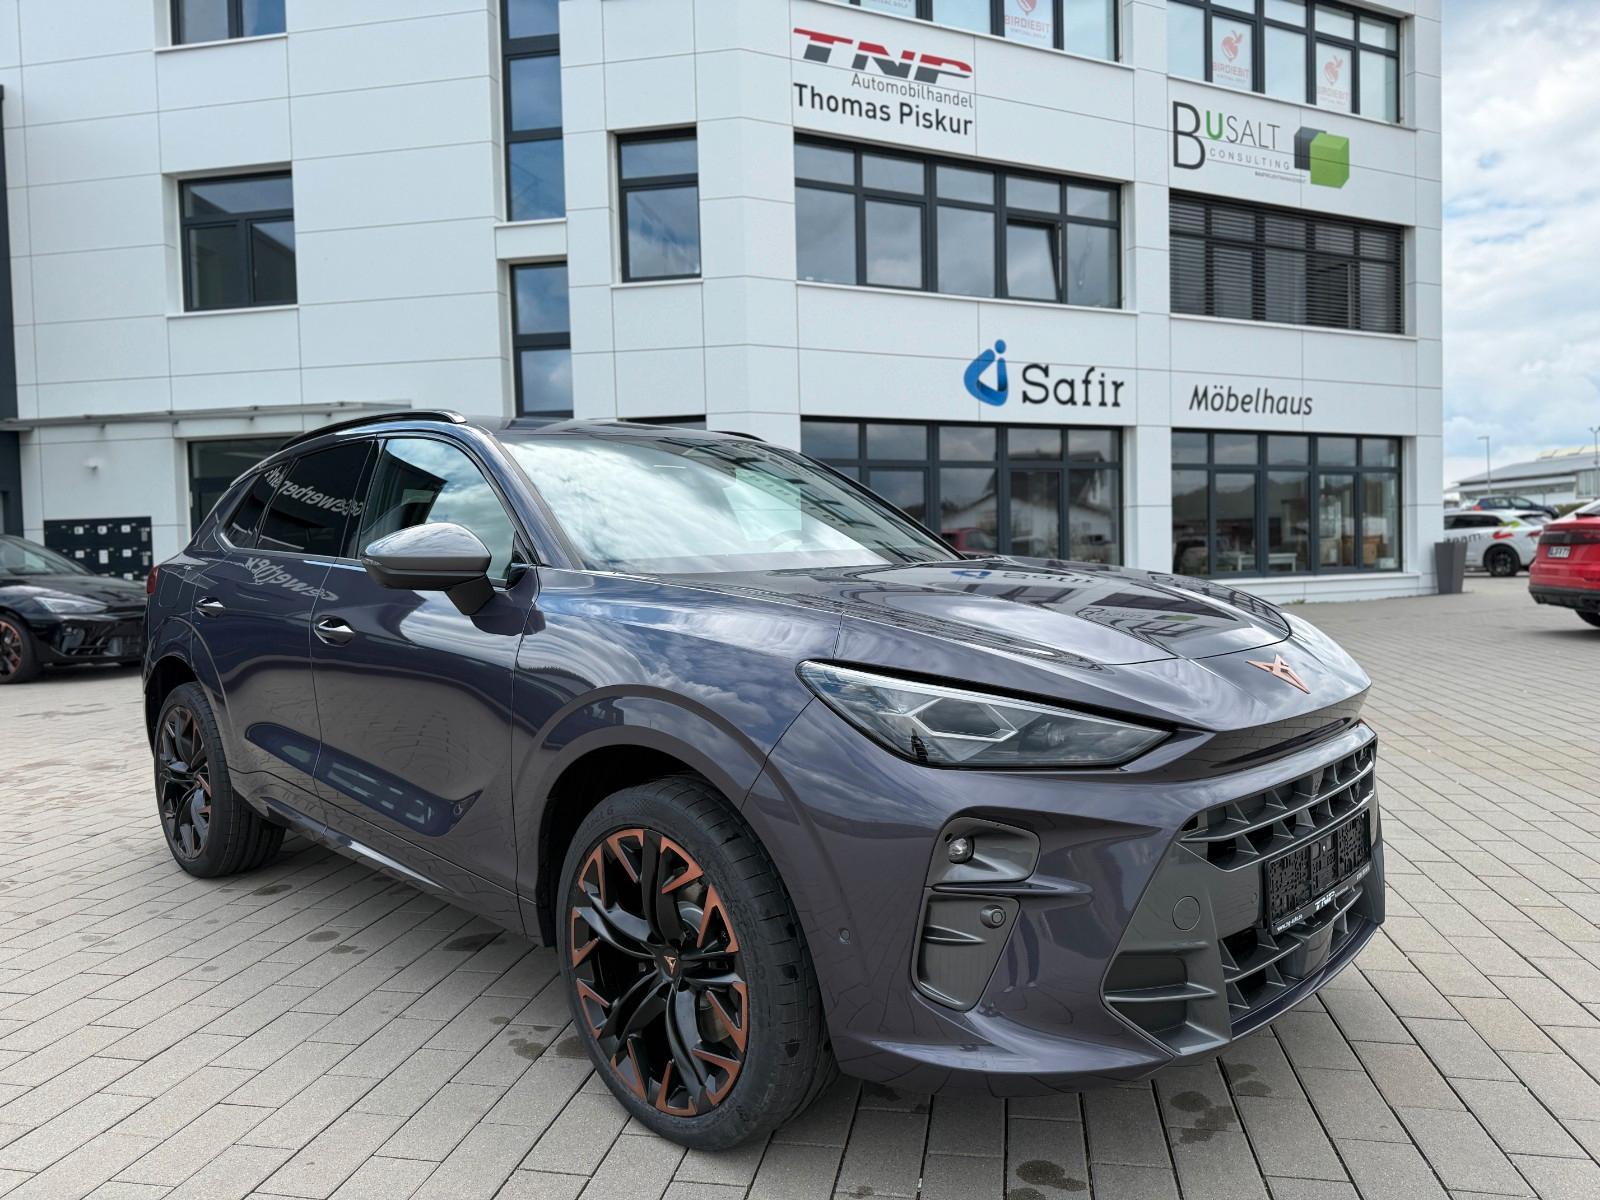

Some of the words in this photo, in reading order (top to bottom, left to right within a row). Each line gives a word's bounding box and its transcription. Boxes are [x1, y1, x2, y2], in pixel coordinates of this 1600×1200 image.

[793, 27, 973, 84] TNP
[793, 82, 891, 122] Thomas
[899, 102, 973, 135] Piskur
[851, 72, 973, 109] Automobilhandel
[1209, 148, 1291, 171] CONSULTING
[1022, 363, 1124, 408] Safir
[1189, 384, 1314, 416] Möbelhaus
